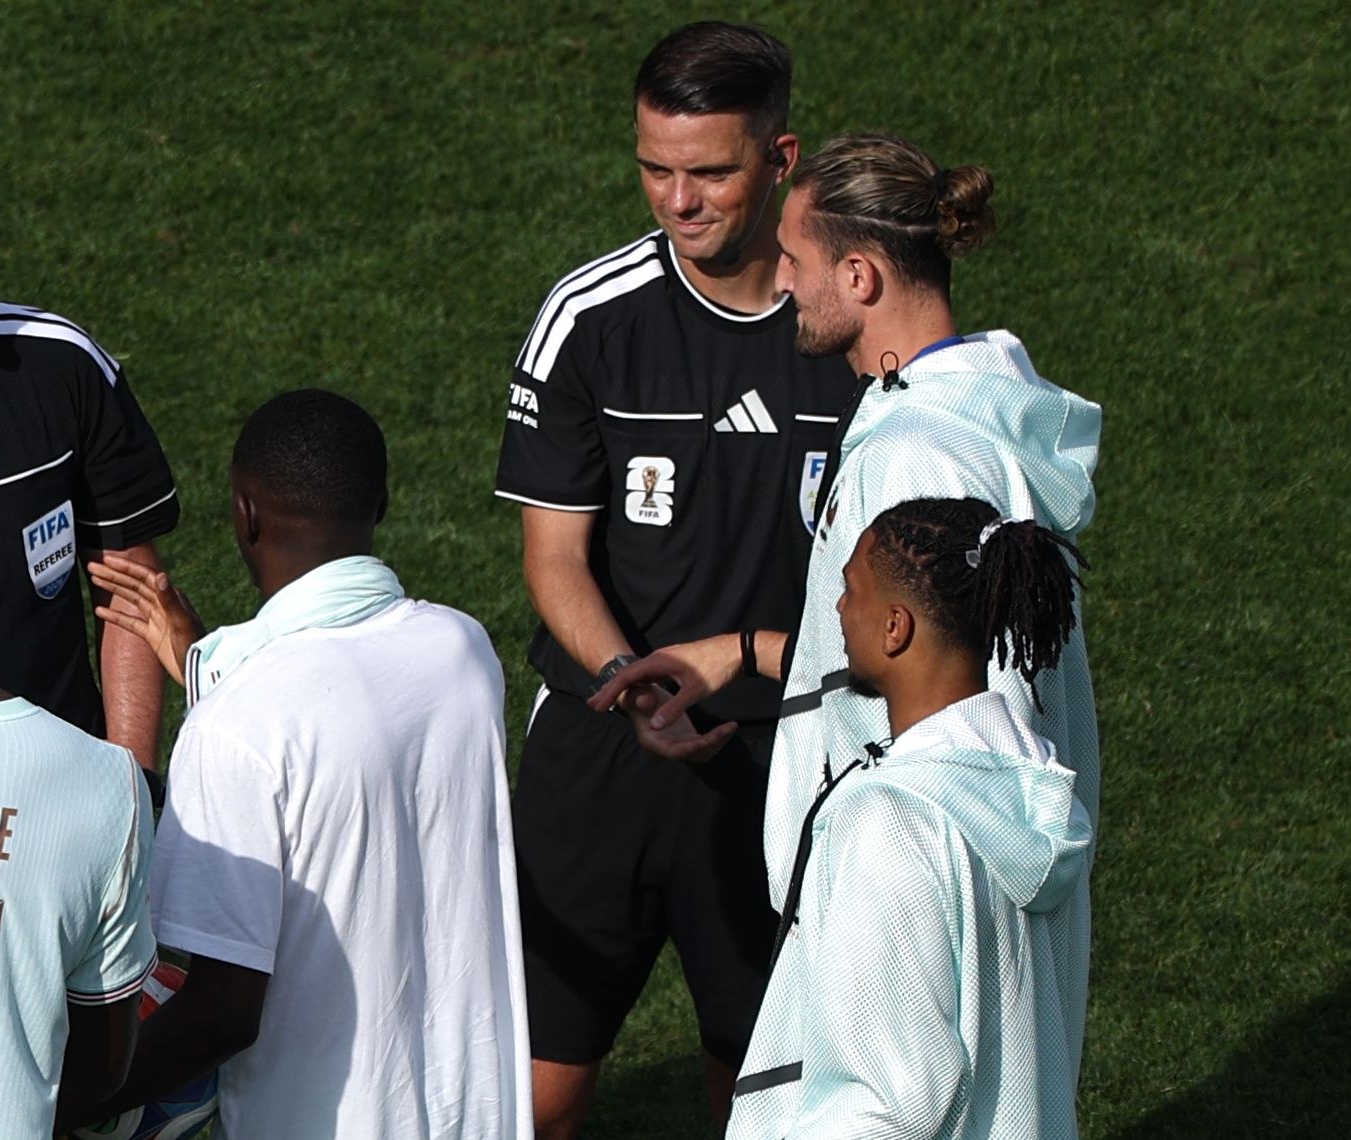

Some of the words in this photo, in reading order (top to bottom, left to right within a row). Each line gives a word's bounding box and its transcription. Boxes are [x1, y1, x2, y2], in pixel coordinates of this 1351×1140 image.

[28, 511, 70, 552] FIFA
[639, 510, 660, 519] FIFA
[33, 542, 74, 576] REFEREE
